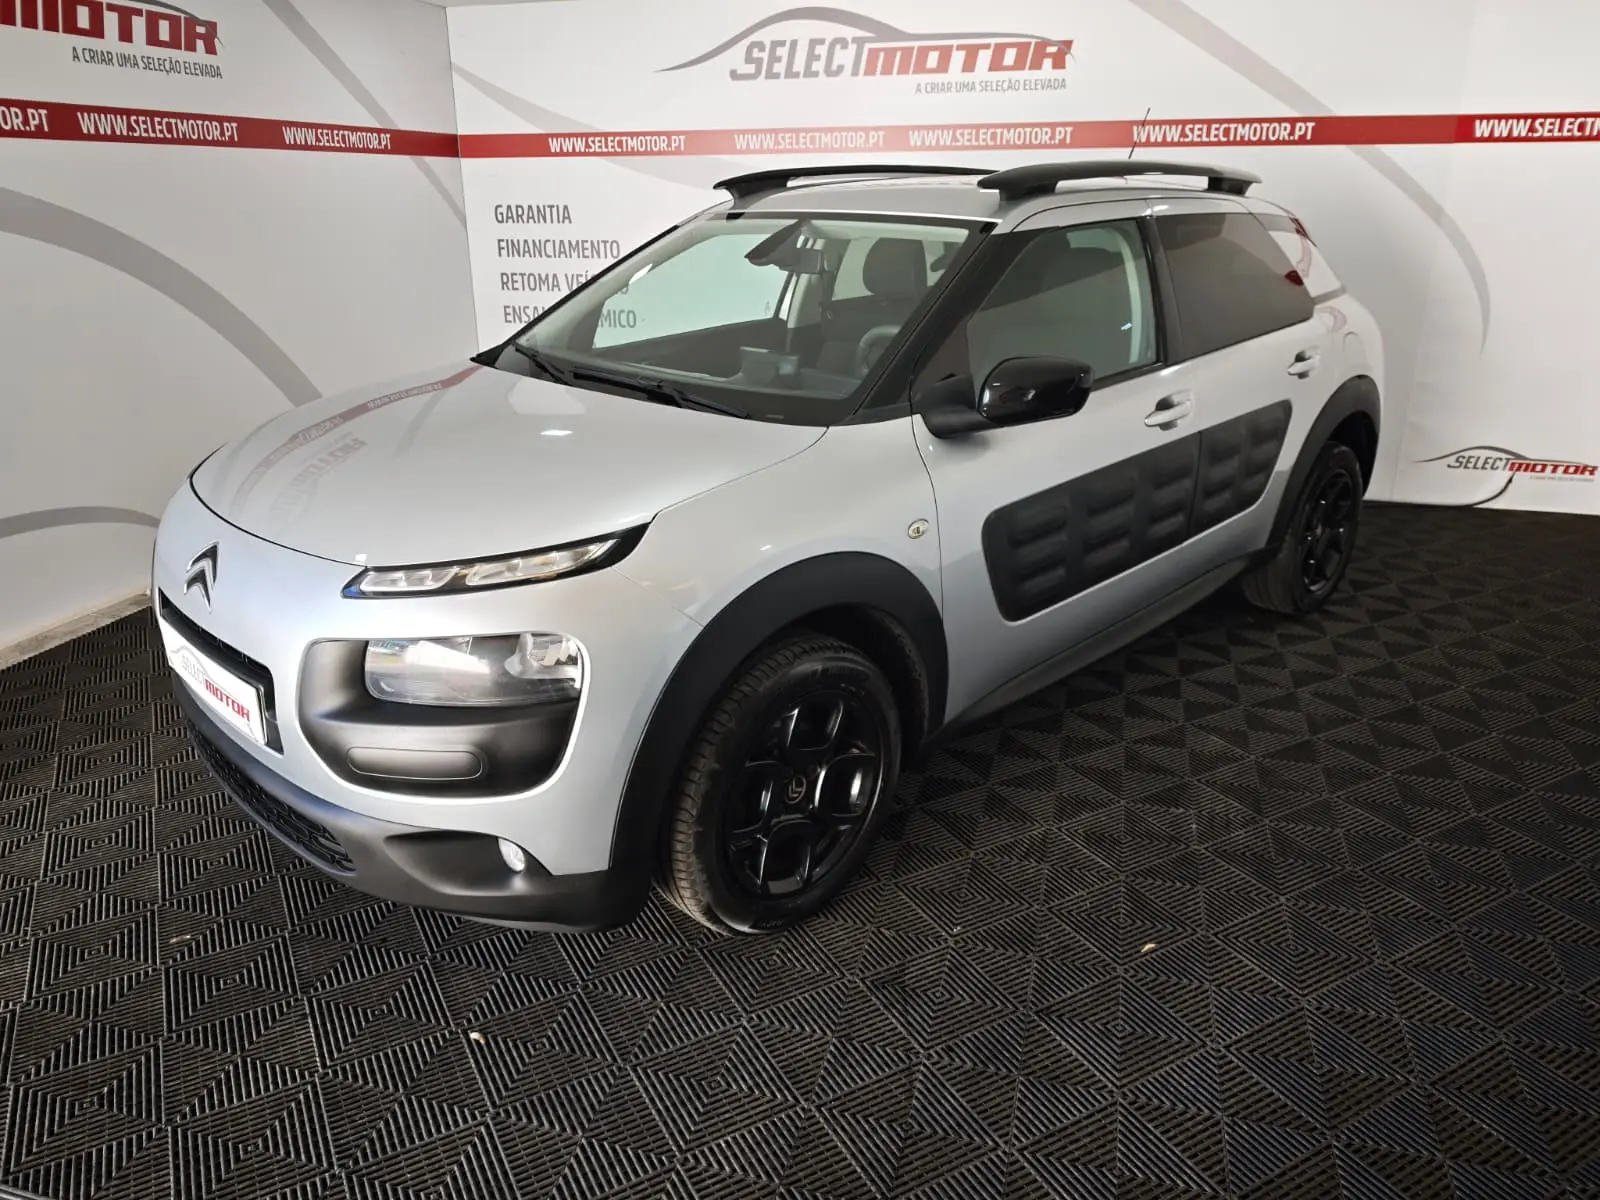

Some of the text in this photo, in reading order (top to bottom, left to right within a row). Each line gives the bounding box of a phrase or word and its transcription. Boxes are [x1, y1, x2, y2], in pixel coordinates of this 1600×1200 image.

[72, 46, 224, 79] A CRIAR UMA SELEÇÃO ELEVADA
[729, 36, 1075, 82] SELECTMOTOR
[915, 77, 1067, 95] A CRIAR UMA SELEÇÃO ELEVADA
[77, 111, 239, 141] WWW.SELECTMOTOR.PT
[1132, 122, 1316, 143] WWW.SELECTMOTOR.PT
[282, 126, 391, 150] WWW.SELECTMOTOR.PT
[548, 135, 686, 152] WWW.SELECTMOTOR.PT
[734, 130, 886, 150] WWW.SELECTMOTOR.PT
[909, 127, 1073, 147] WWW.SELECTMOTOR.PT
[494, 204, 572, 224] GARANTIA
[497, 238, 620, 259] FINANCIAMENTO
[500, 272, 561, 292] RETOMA
[1447, 455, 1598, 476] SELECTMOTOR
